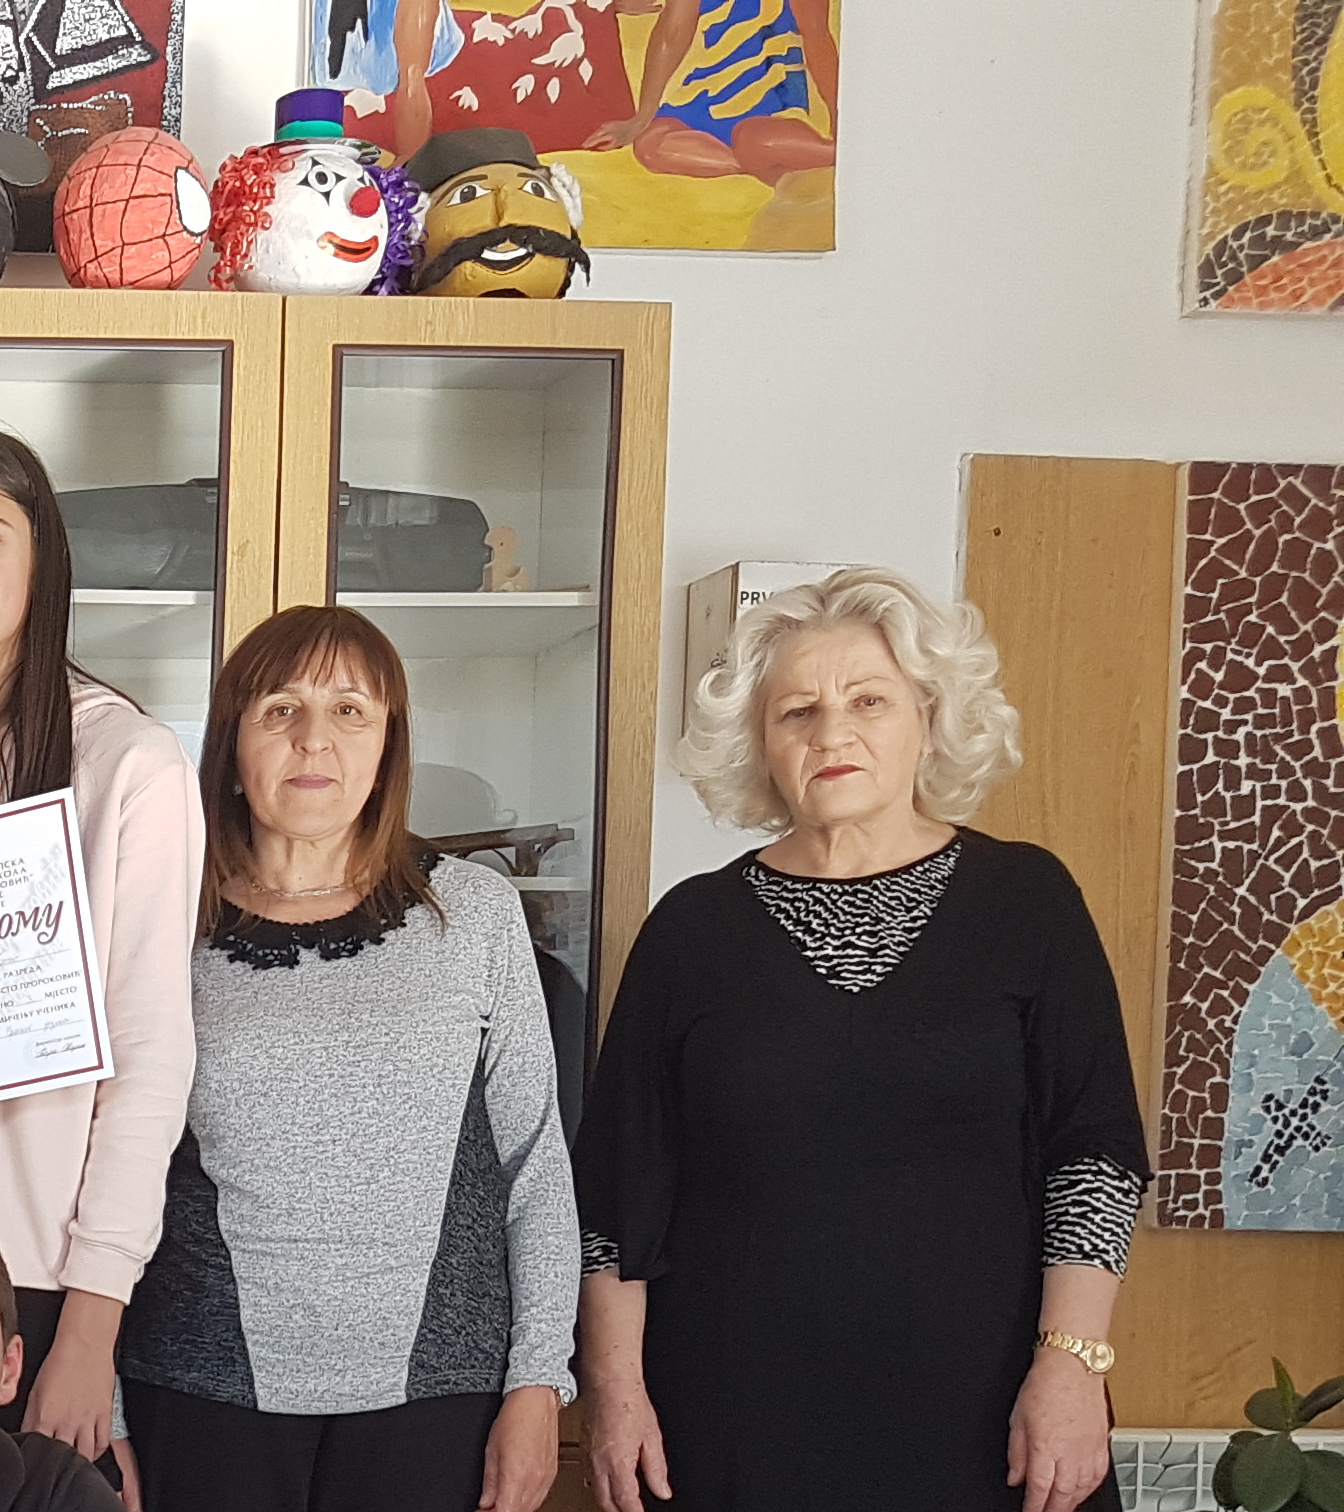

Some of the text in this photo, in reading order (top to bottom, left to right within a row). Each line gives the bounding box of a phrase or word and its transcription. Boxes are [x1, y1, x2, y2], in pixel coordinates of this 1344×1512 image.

[2, 963, 42, 979] РАЗРЕДА
[43, 984, 77, 999] МЈЕСТО
[34, 1000, 76, 1016] УЧЕНИКА
